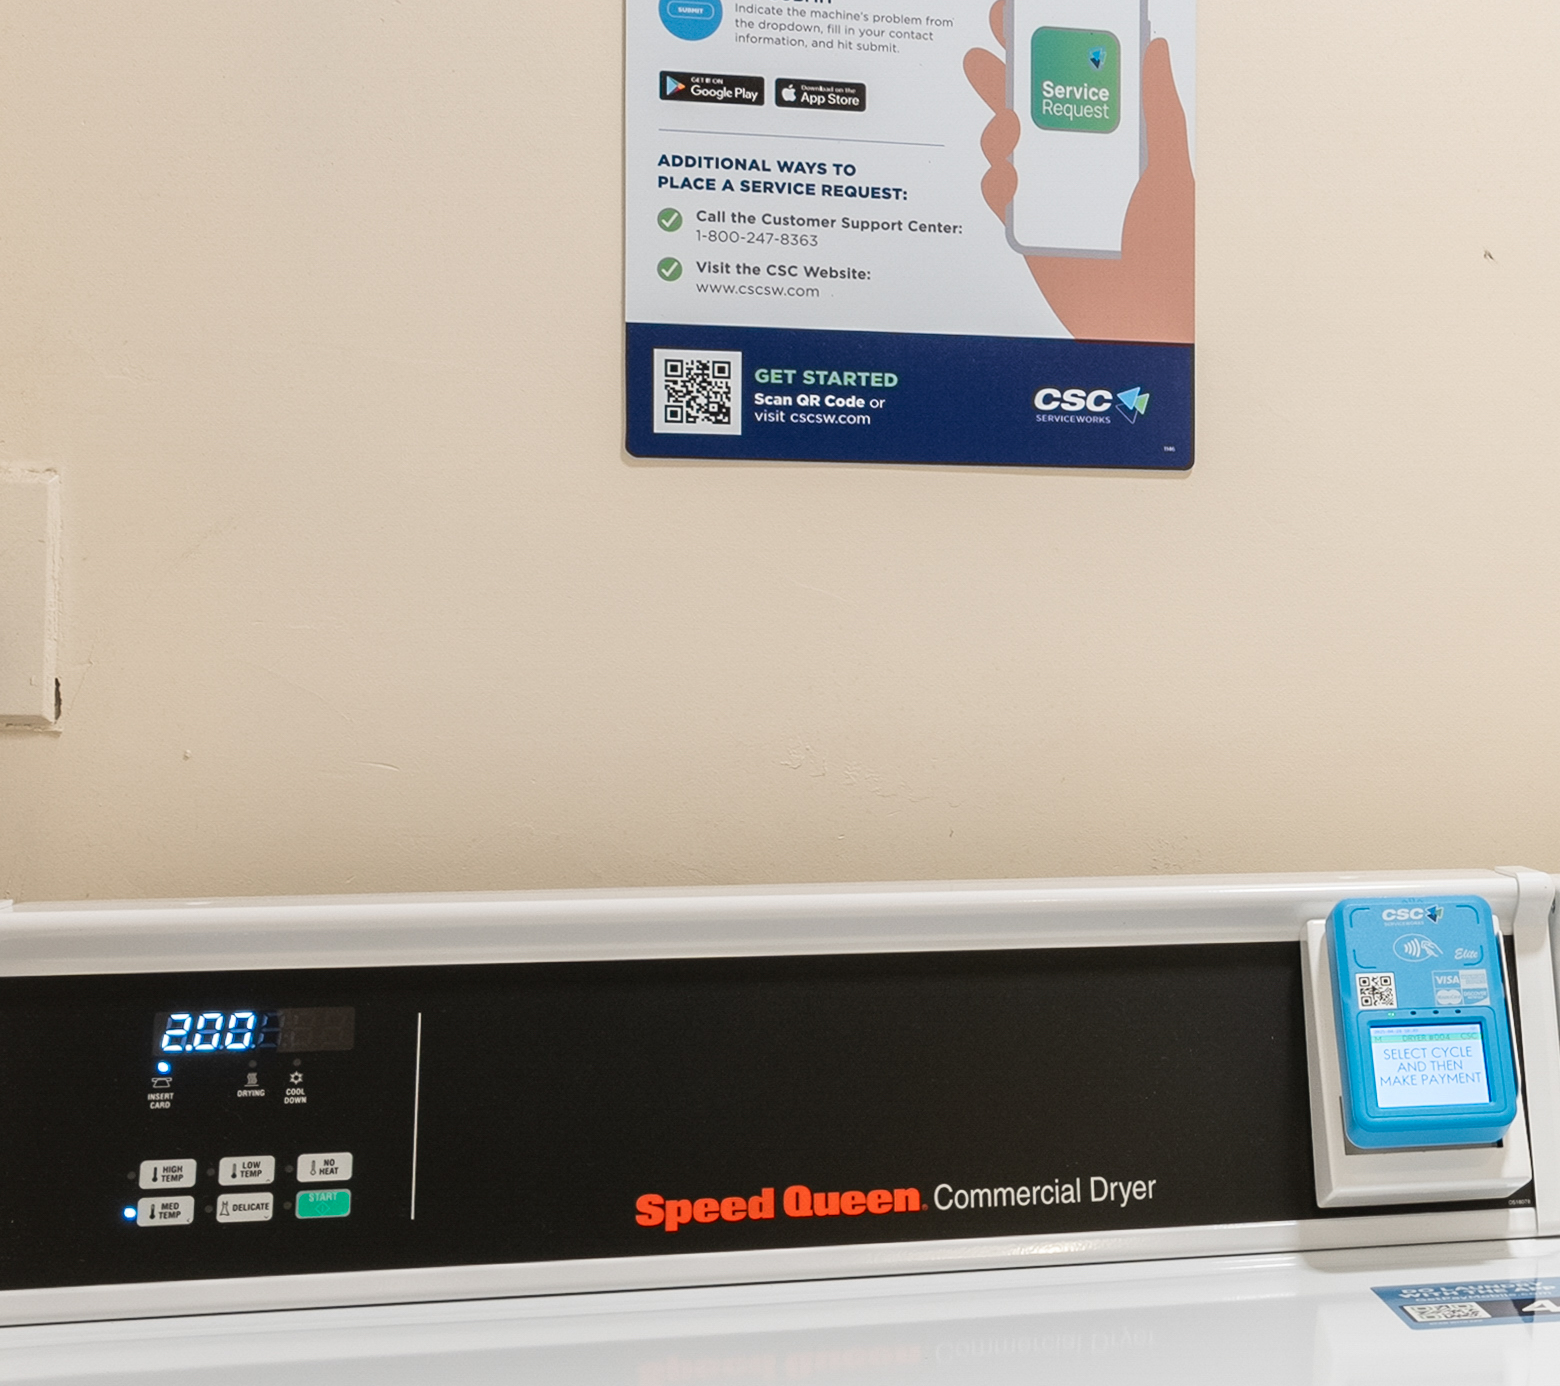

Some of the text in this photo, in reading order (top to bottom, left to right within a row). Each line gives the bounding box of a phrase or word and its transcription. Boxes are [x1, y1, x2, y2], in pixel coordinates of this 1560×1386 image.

[1042, 79, 1110, 102] Service
[1042, 98, 1110, 121] Request
[657, 154, 857, 177] ADDITIONAL WAYS TO
[658, 175, 908, 201] PLACE A SERVICE REQUEST:
[696, 209, 962, 235] Call the Customer Support Center:
[696, 229, 819, 247] 1-800-247-8363
[754, 368, 899, 388] GET STARTED
[754, 392, 886, 409] Scan QR Code or
[1033, 387, 1114, 413] CSC
[754, 409, 871, 425] visit cscsw.com
[1035, 414, 1111, 424] SERVICEWORKS
[161, 1011, 257, 1053] 2.00
[1383, 1045, 1473, 1061] SELECT CYCLE
[1397, 1059, 1463, 1073] AND THEN
[1379, 1071, 1482, 1087] MAKE PAYMENT
[162, 1164, 184, 1174] HIGH
[161, 1173, 184, 1183] TEMP
[308, 1192, 338, 1203] START
[636, 1175, 1157, 1231] Speed Queen Commercial Dryer
[232, 1202, 270, 1212] DELICATE
